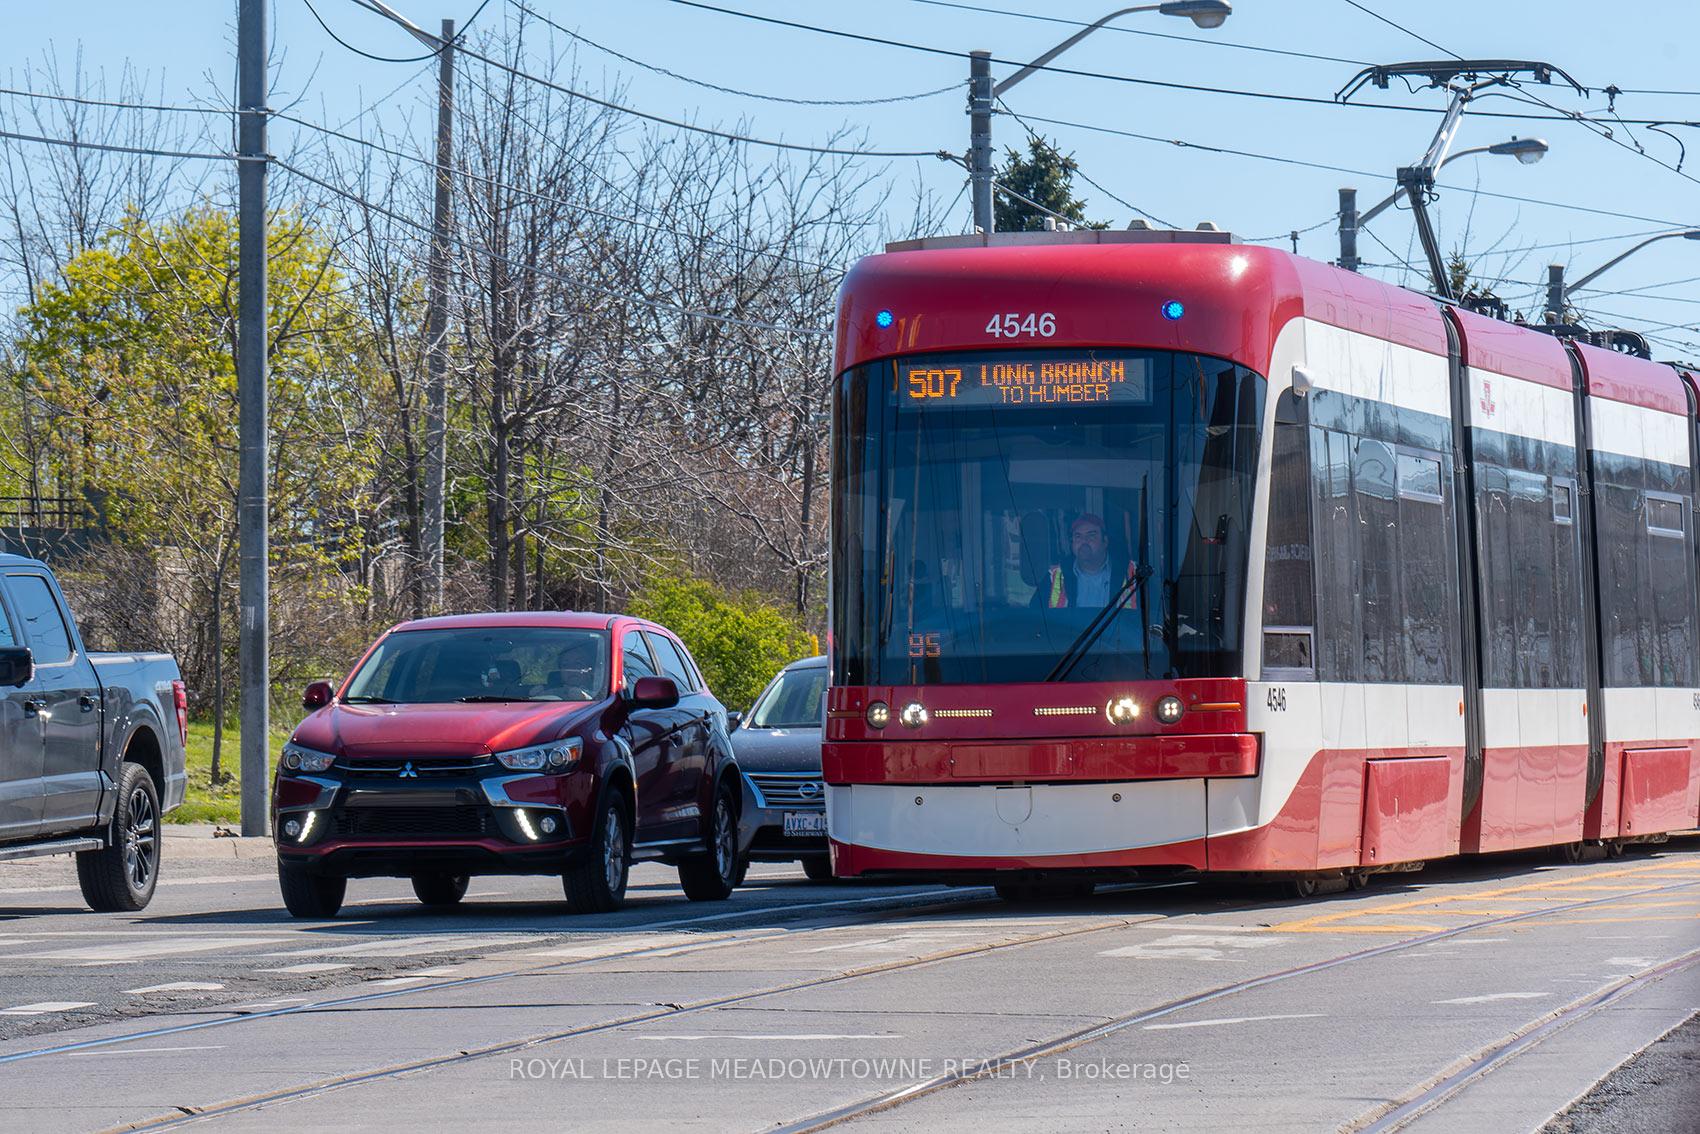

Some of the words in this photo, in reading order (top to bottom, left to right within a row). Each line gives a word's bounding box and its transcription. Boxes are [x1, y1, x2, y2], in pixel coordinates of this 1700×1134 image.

[985, 312, 1056, 338] 4546
[909, 369, 961, 398] 507
[980, 363, 1035, 386] LONG
[1040, 361, 1125, 385] BRANCH
[998, 385, 1024, 403] TO
[1029, 383, 1109, 403] HUMBER
[1267, 688, 1287, 711] 4546
